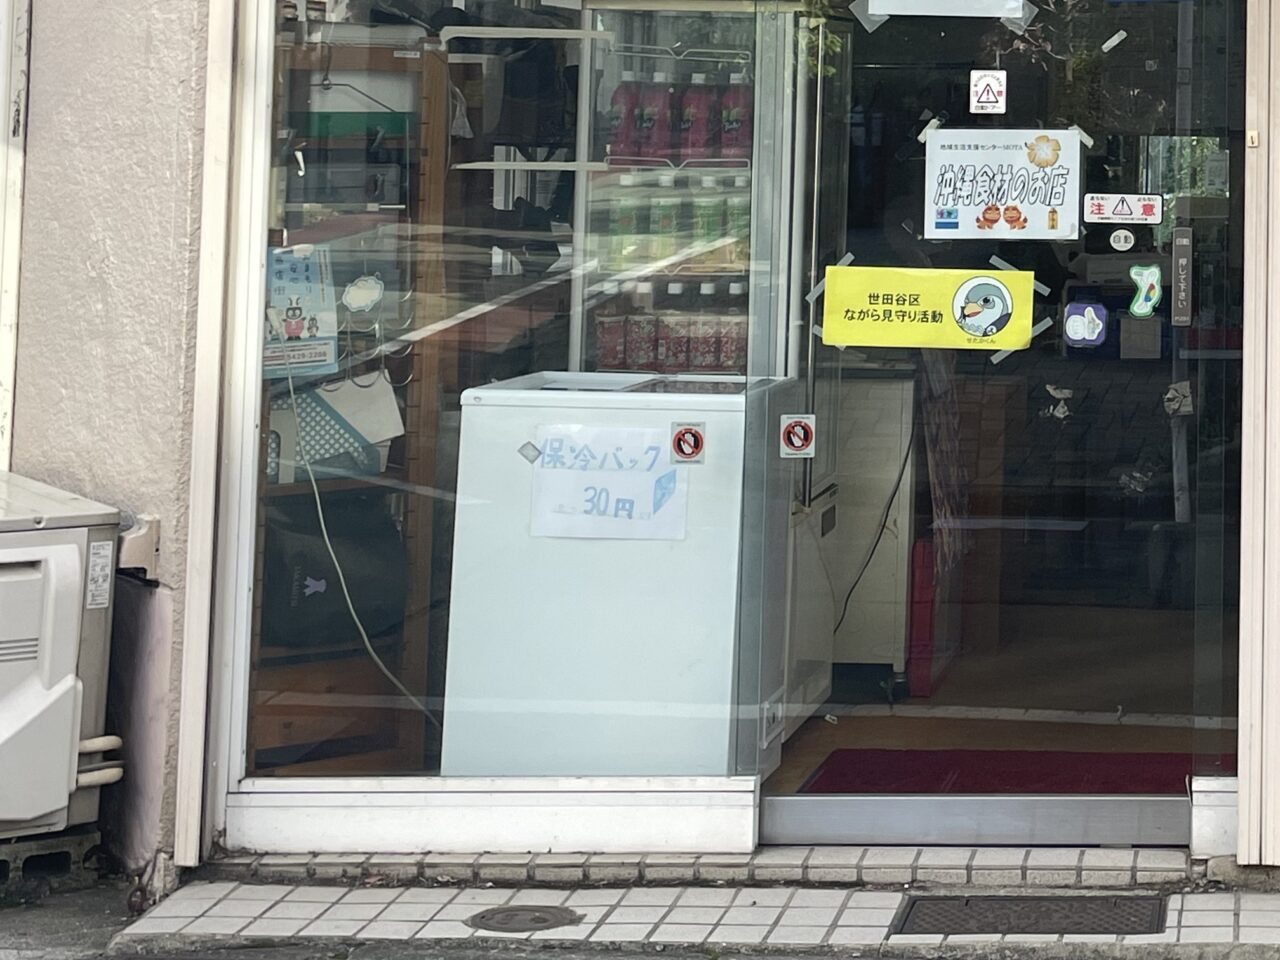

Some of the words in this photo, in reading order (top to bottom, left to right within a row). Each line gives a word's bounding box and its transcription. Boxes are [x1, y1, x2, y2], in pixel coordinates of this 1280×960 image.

[933, 163, 1071, 207] 沖縄食材のお店
[1112, 234, 1132, 244] 自動
[867, 292, 921, 307] 世田谷区
[843, 308, 944, 325] ながら見守り活動
